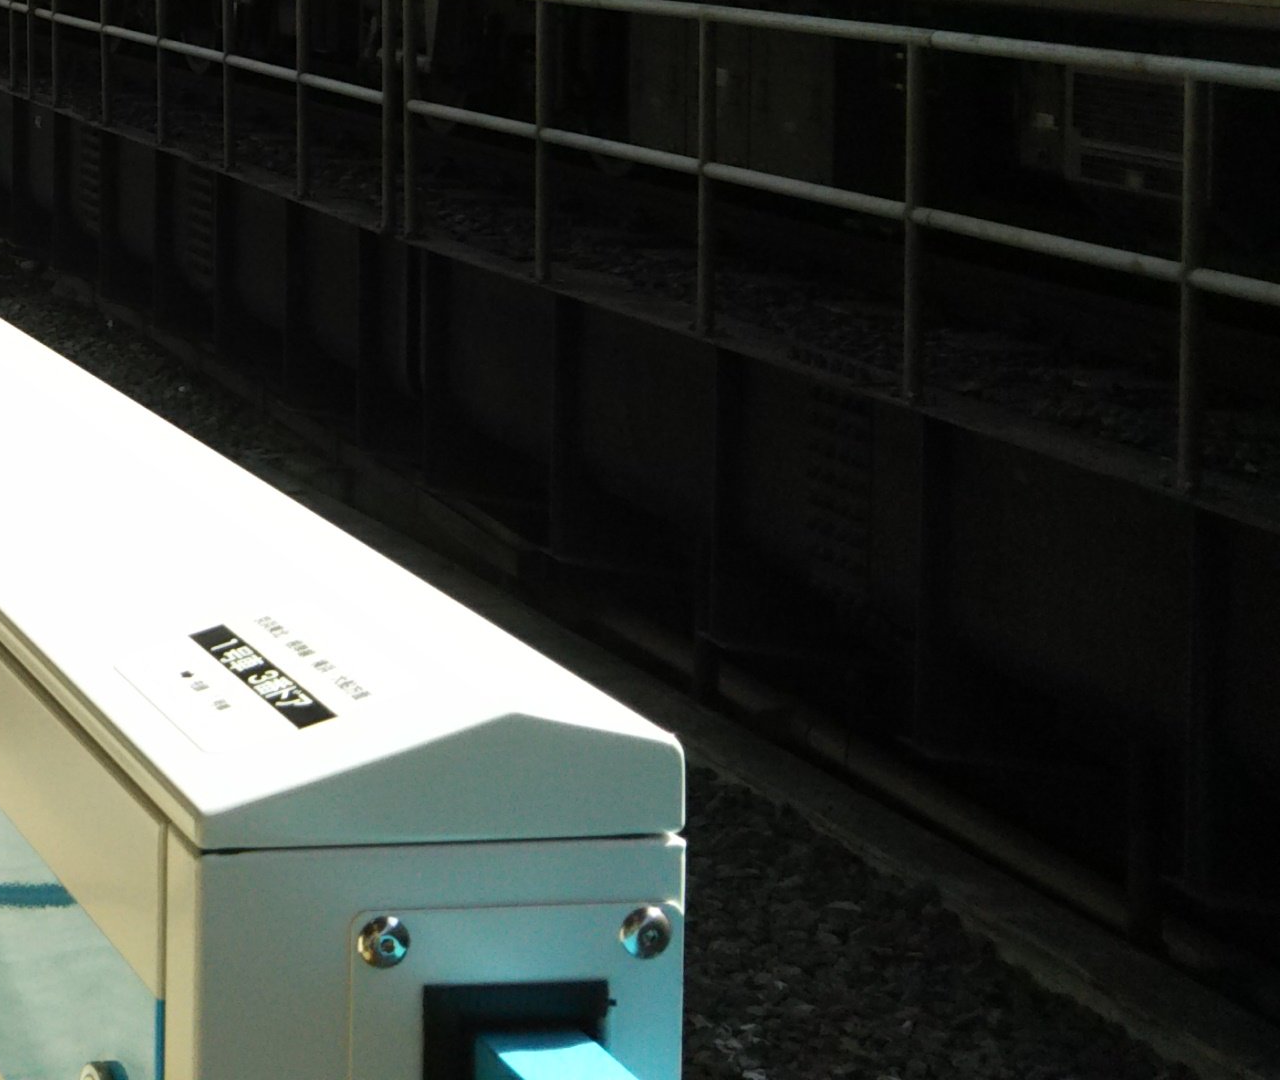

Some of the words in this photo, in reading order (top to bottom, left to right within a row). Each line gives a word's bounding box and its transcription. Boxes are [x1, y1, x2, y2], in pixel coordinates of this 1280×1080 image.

[210, 638, 264, 673] 1号車
[248, 669, 314, 707] 3番ドア
